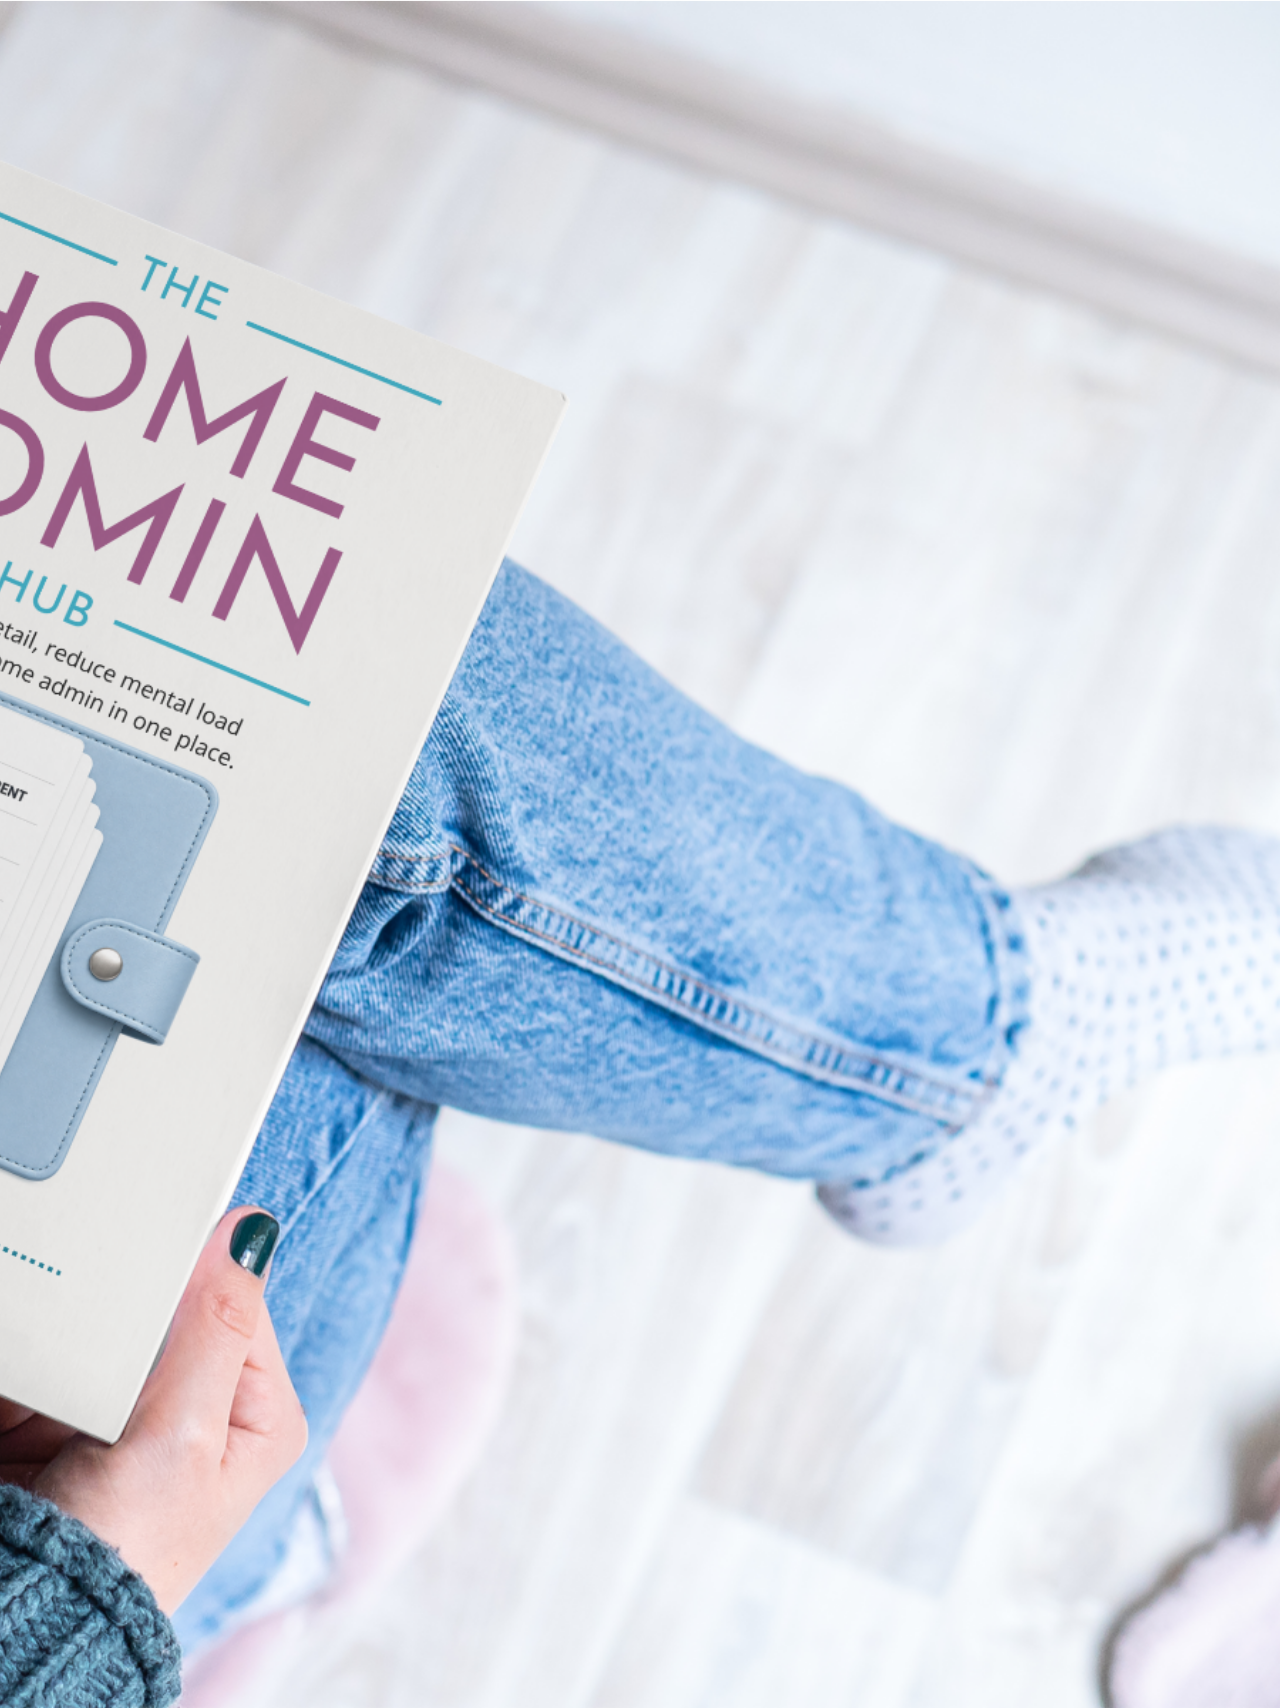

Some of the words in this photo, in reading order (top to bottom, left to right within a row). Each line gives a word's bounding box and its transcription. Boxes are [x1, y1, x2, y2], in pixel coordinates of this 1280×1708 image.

[139, 253, 230, 321] THE
[37, 674, 104, 714] admin
[107, 699, 129, 724] in
[132, 714, 173, 743] one
[172, 732, 234, 770] place.
[43, 642, 117, 684] reduce
[118, 674, 195, 716] mental
[195, 701, 244, 737] load
